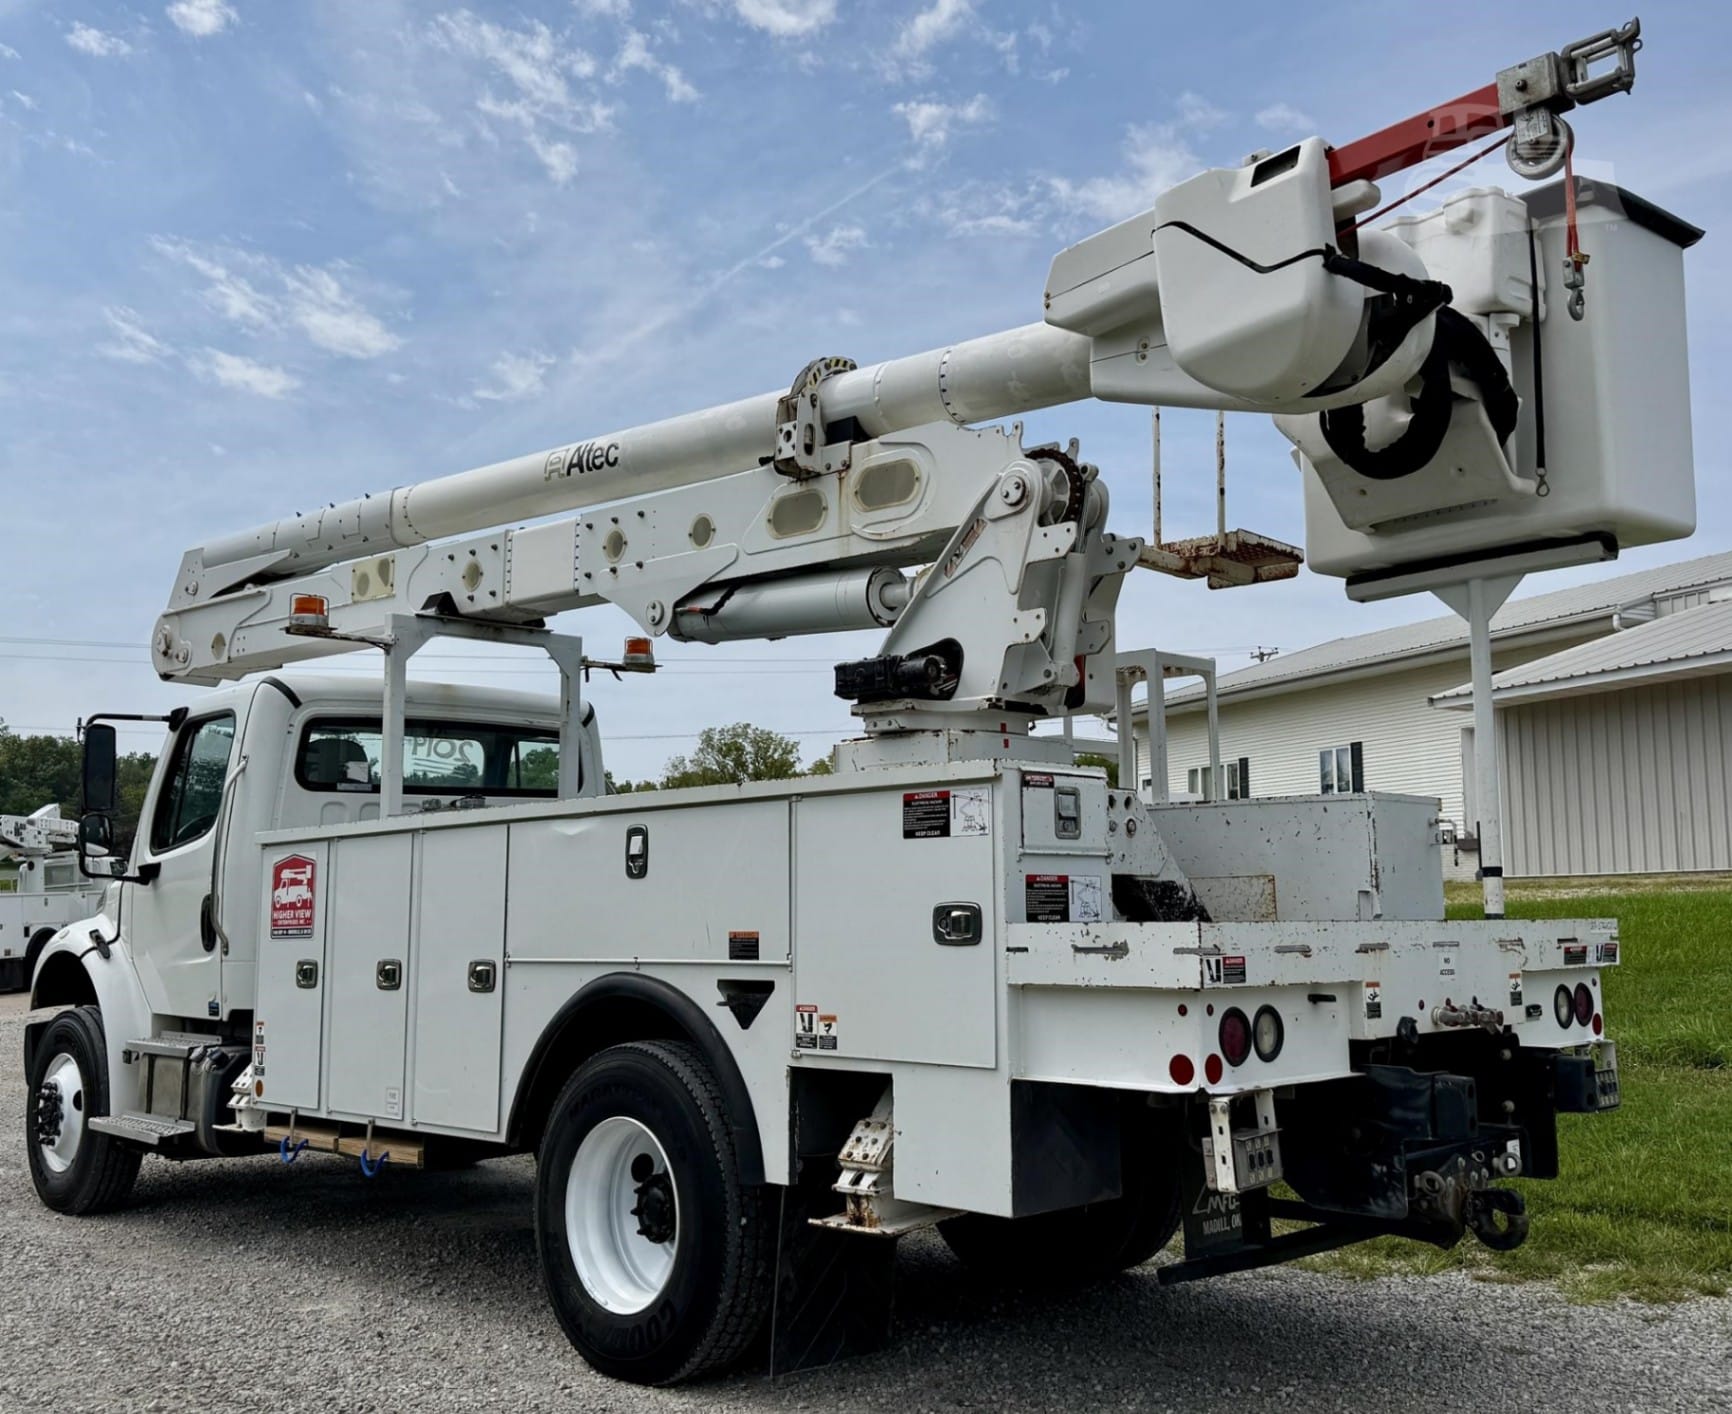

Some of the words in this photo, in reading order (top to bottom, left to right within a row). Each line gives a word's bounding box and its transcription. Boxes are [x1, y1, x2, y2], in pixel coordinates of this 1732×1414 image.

[566, 442, 619, 477] Altec
[919, 791, 938, 799] DANGER
[273, 909, 294, 919] HIGHER
[295, 909, 311, 918] VIEW
